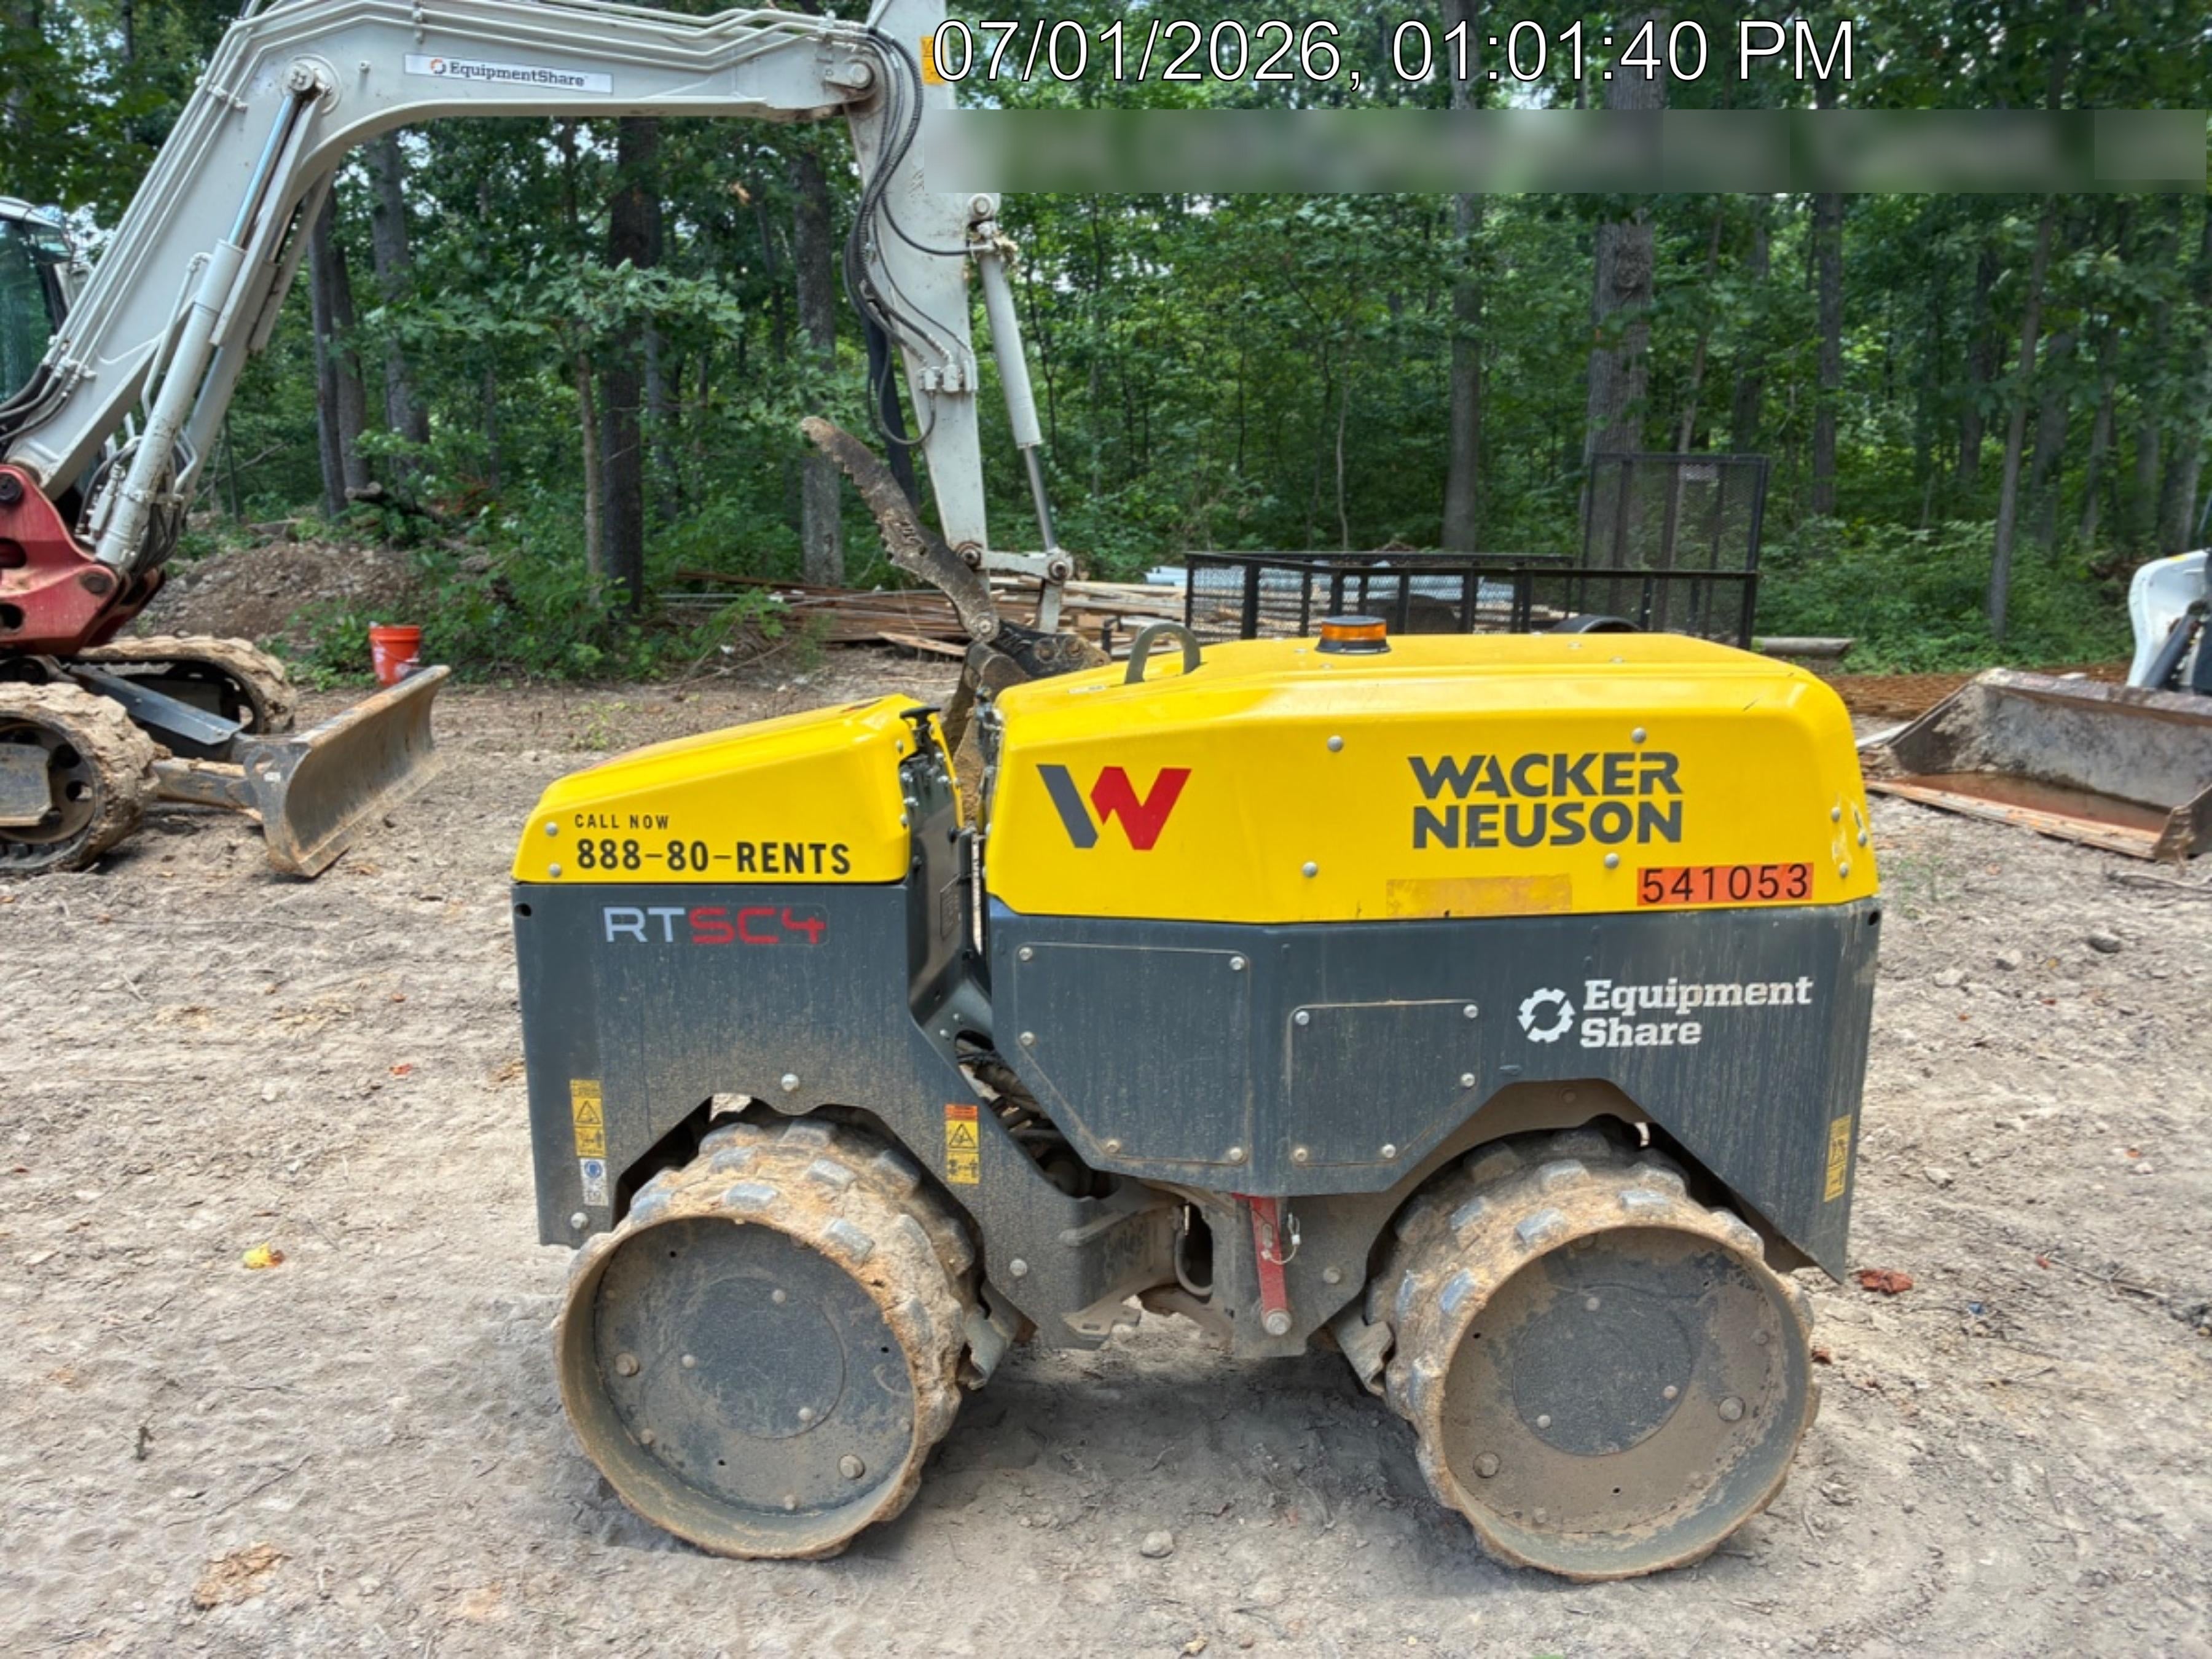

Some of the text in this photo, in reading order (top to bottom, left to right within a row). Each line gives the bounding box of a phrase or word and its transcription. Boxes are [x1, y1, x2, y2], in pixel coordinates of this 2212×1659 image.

[450, 61, 586, 87] EquipmentShare
[1408, 752, 1682, 799] WACKER
[575, 814, 669, 830] CALL NOW
[1413, 801, 1682, 849] NEUSON
[577, 838, 851, 875] 888-80-RENTS
[1642, 863, 1808, 904] 541053
[603, 906, 826, 944] RTSC4
[1583, 976, 1814, 1016] Equipment
[1580, 1018, 1701, 1048] Share
